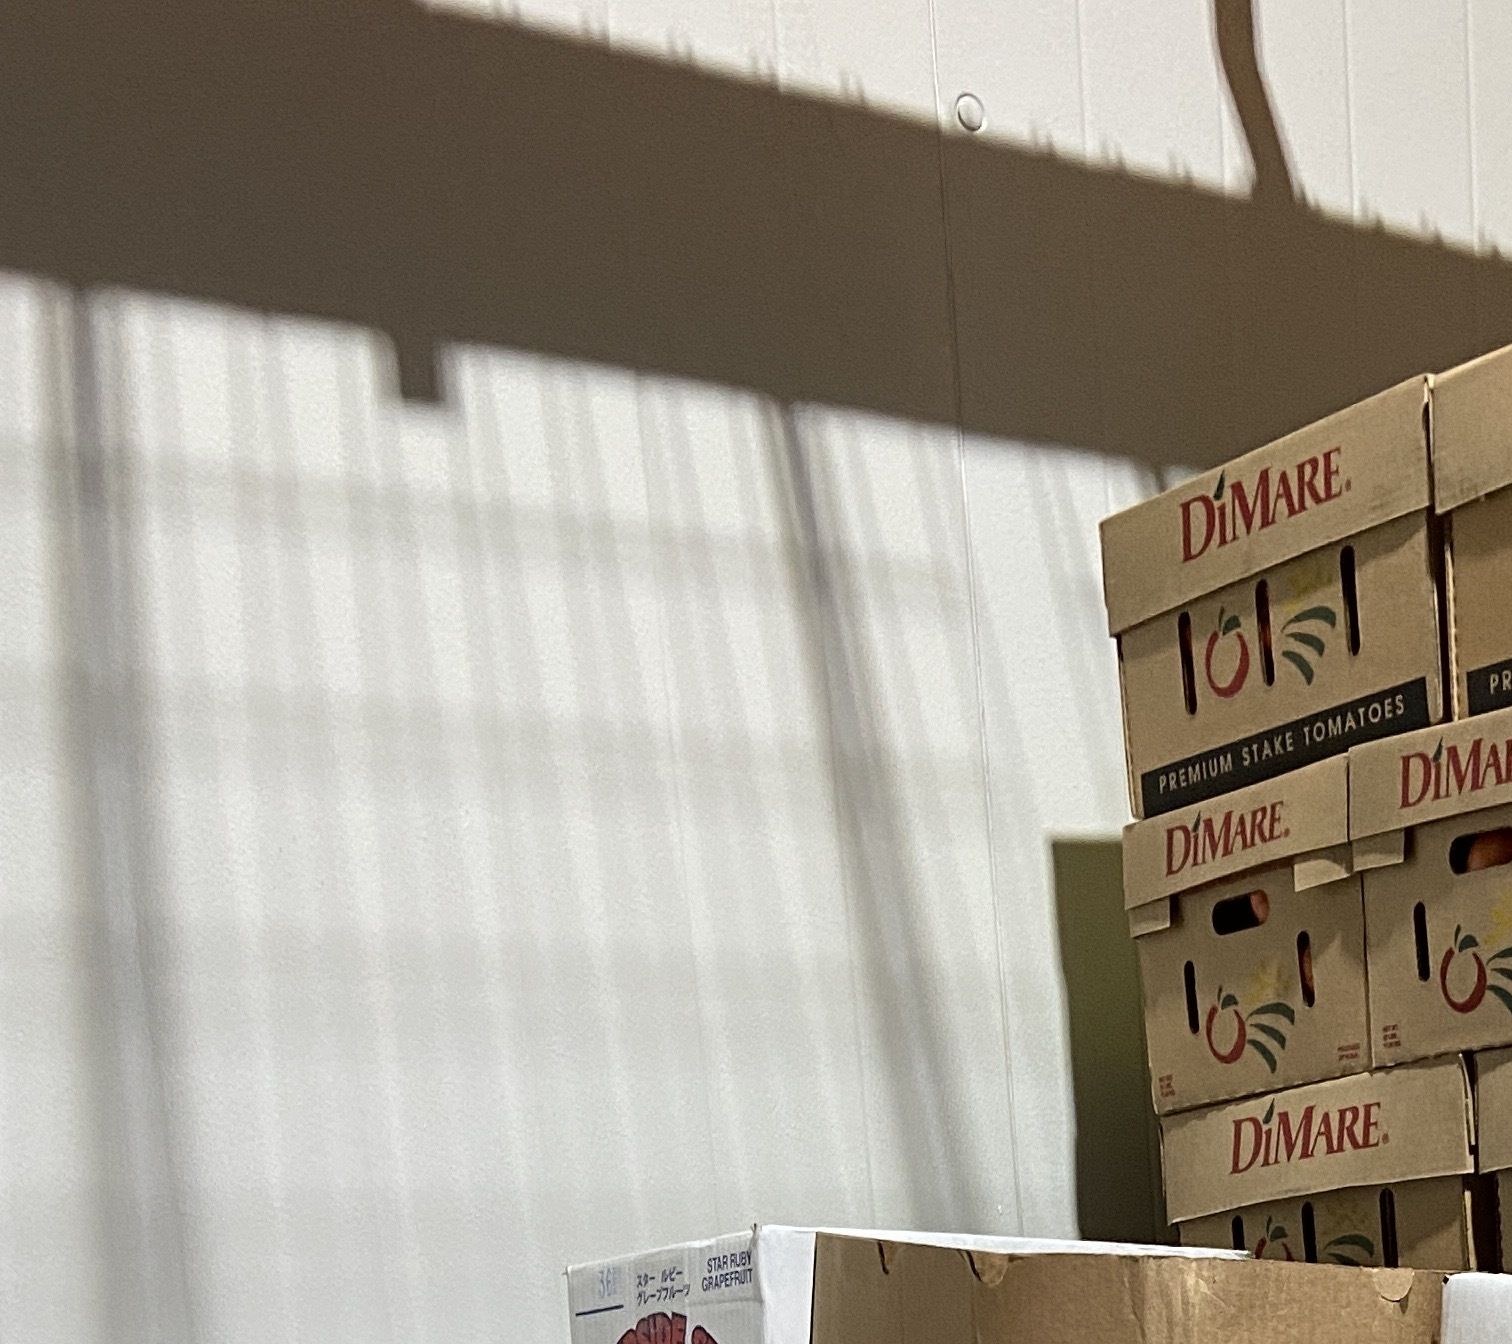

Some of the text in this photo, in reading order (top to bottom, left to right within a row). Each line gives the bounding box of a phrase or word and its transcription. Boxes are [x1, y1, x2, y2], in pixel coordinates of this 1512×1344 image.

[1180, 448, 1342, 563] DiMARE
[1159, 695, 1406, 792] PREMIUM STAKE TOMATOES
[1166, 802, 1283, 877] DiMARE
[1230, 1099, 1381, 1175] DiMARE
[702, 1269, 753, 1291] GRAPEFRUIT
[707, 1251, 752, 1273] STAR RUBY
